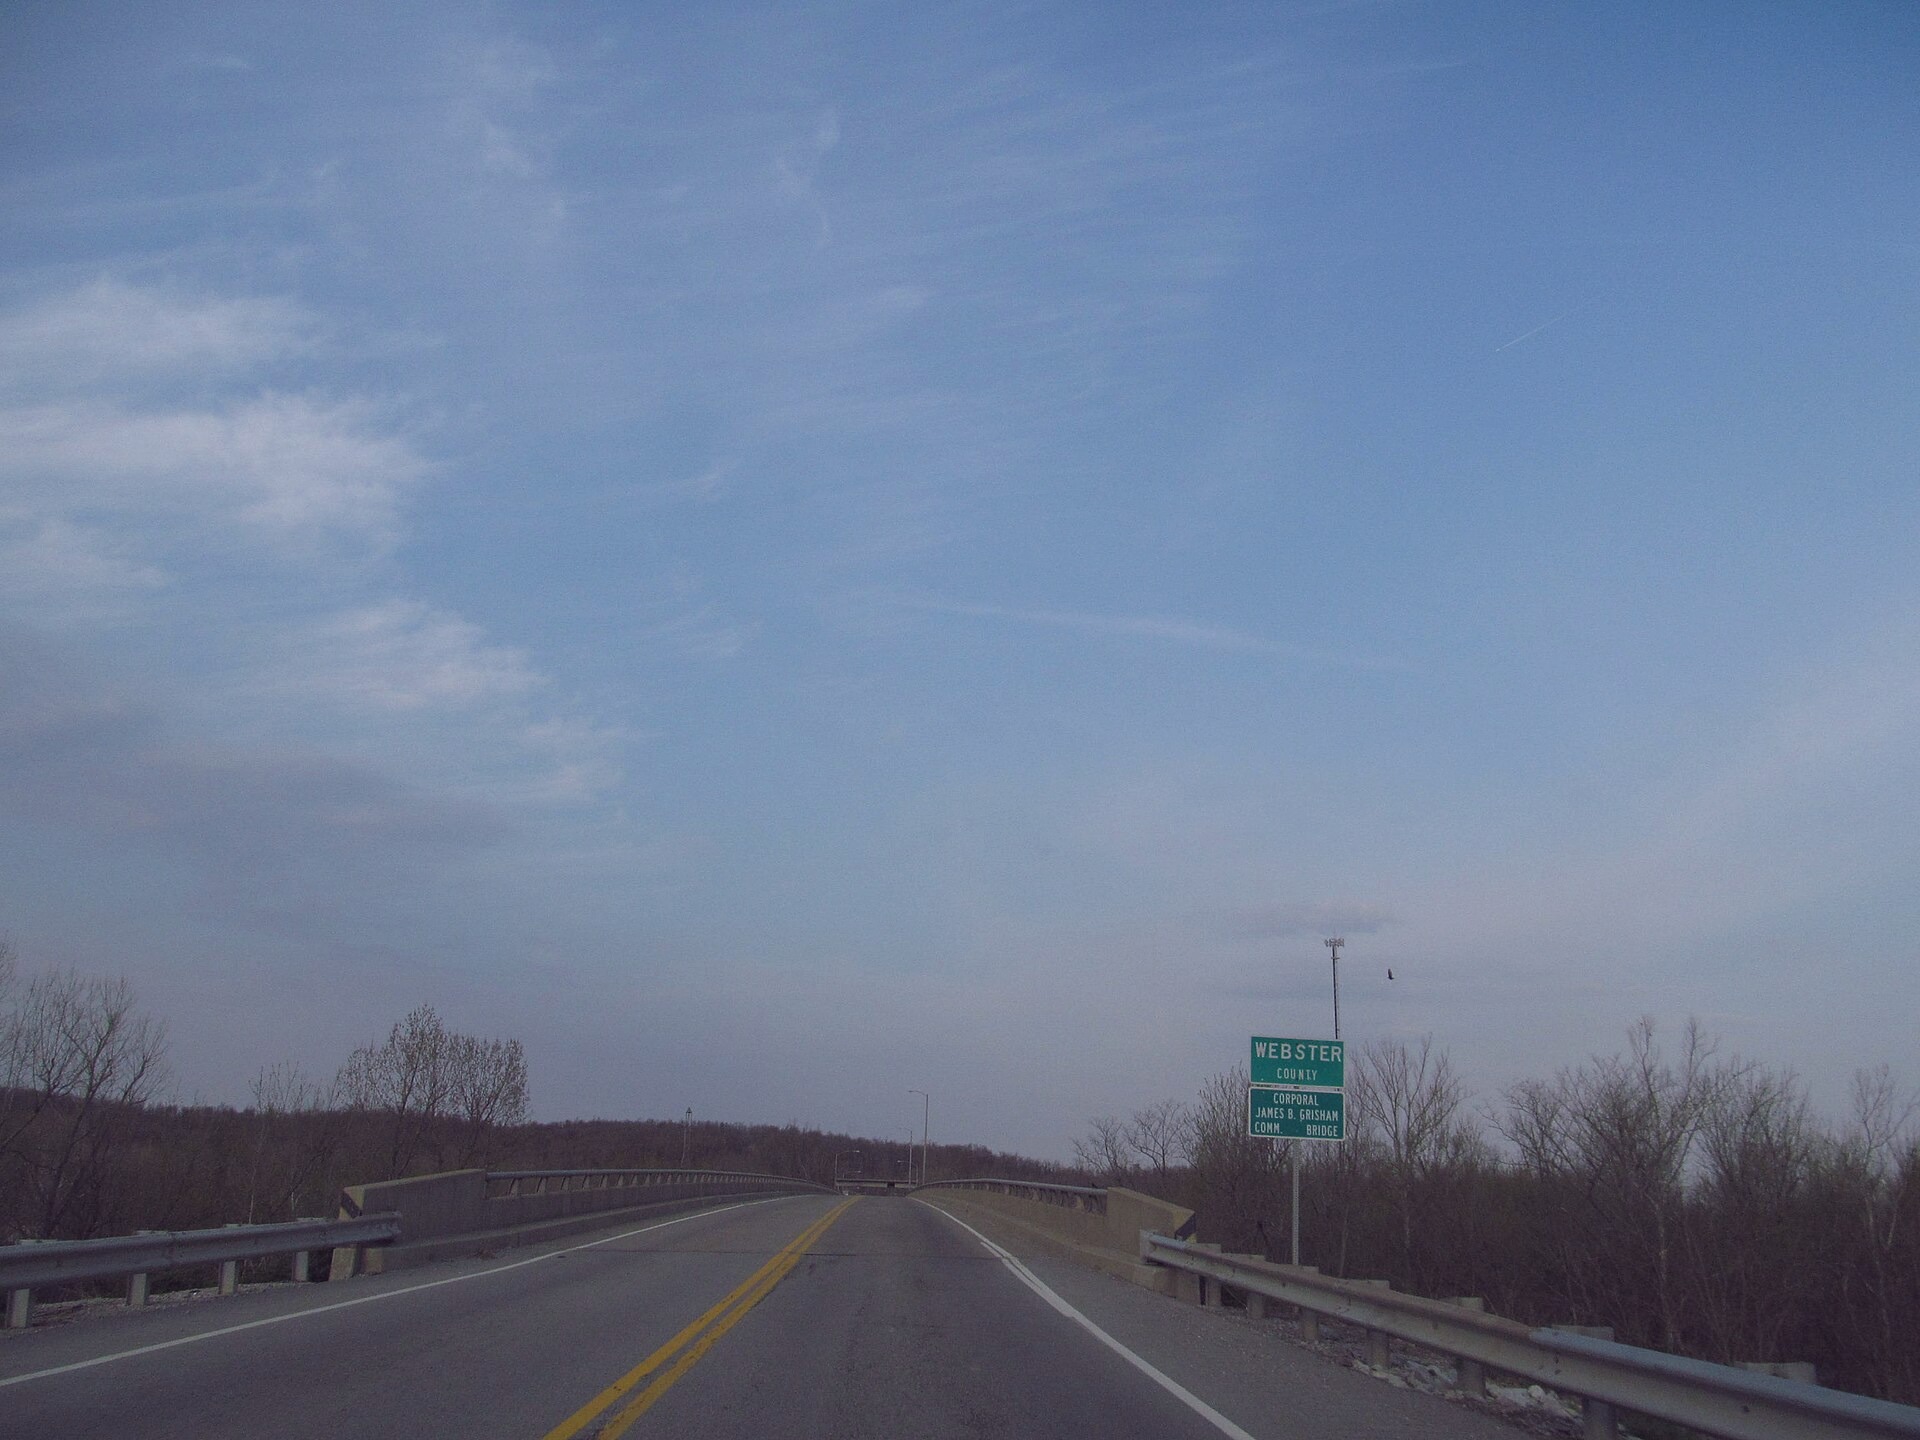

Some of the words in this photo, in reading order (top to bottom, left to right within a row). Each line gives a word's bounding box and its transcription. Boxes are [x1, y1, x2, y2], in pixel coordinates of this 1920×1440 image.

[1255, 1041, 1342, 1062] WEBSTER
[1277, 1068, 1318, 1081] COUNTY
[1273, 1092, 1319, 1106] CORPORAL
[1255, 1107, 1284, 1119] JAMES
[1288, 1108, 1296, 1120] B.
[1299, 1108, 1338, 1121] GRISHAM
[1255, 1121, 1283, 1134] COMM.
[1306, 1124, 1338, 1137] BRIDGE
